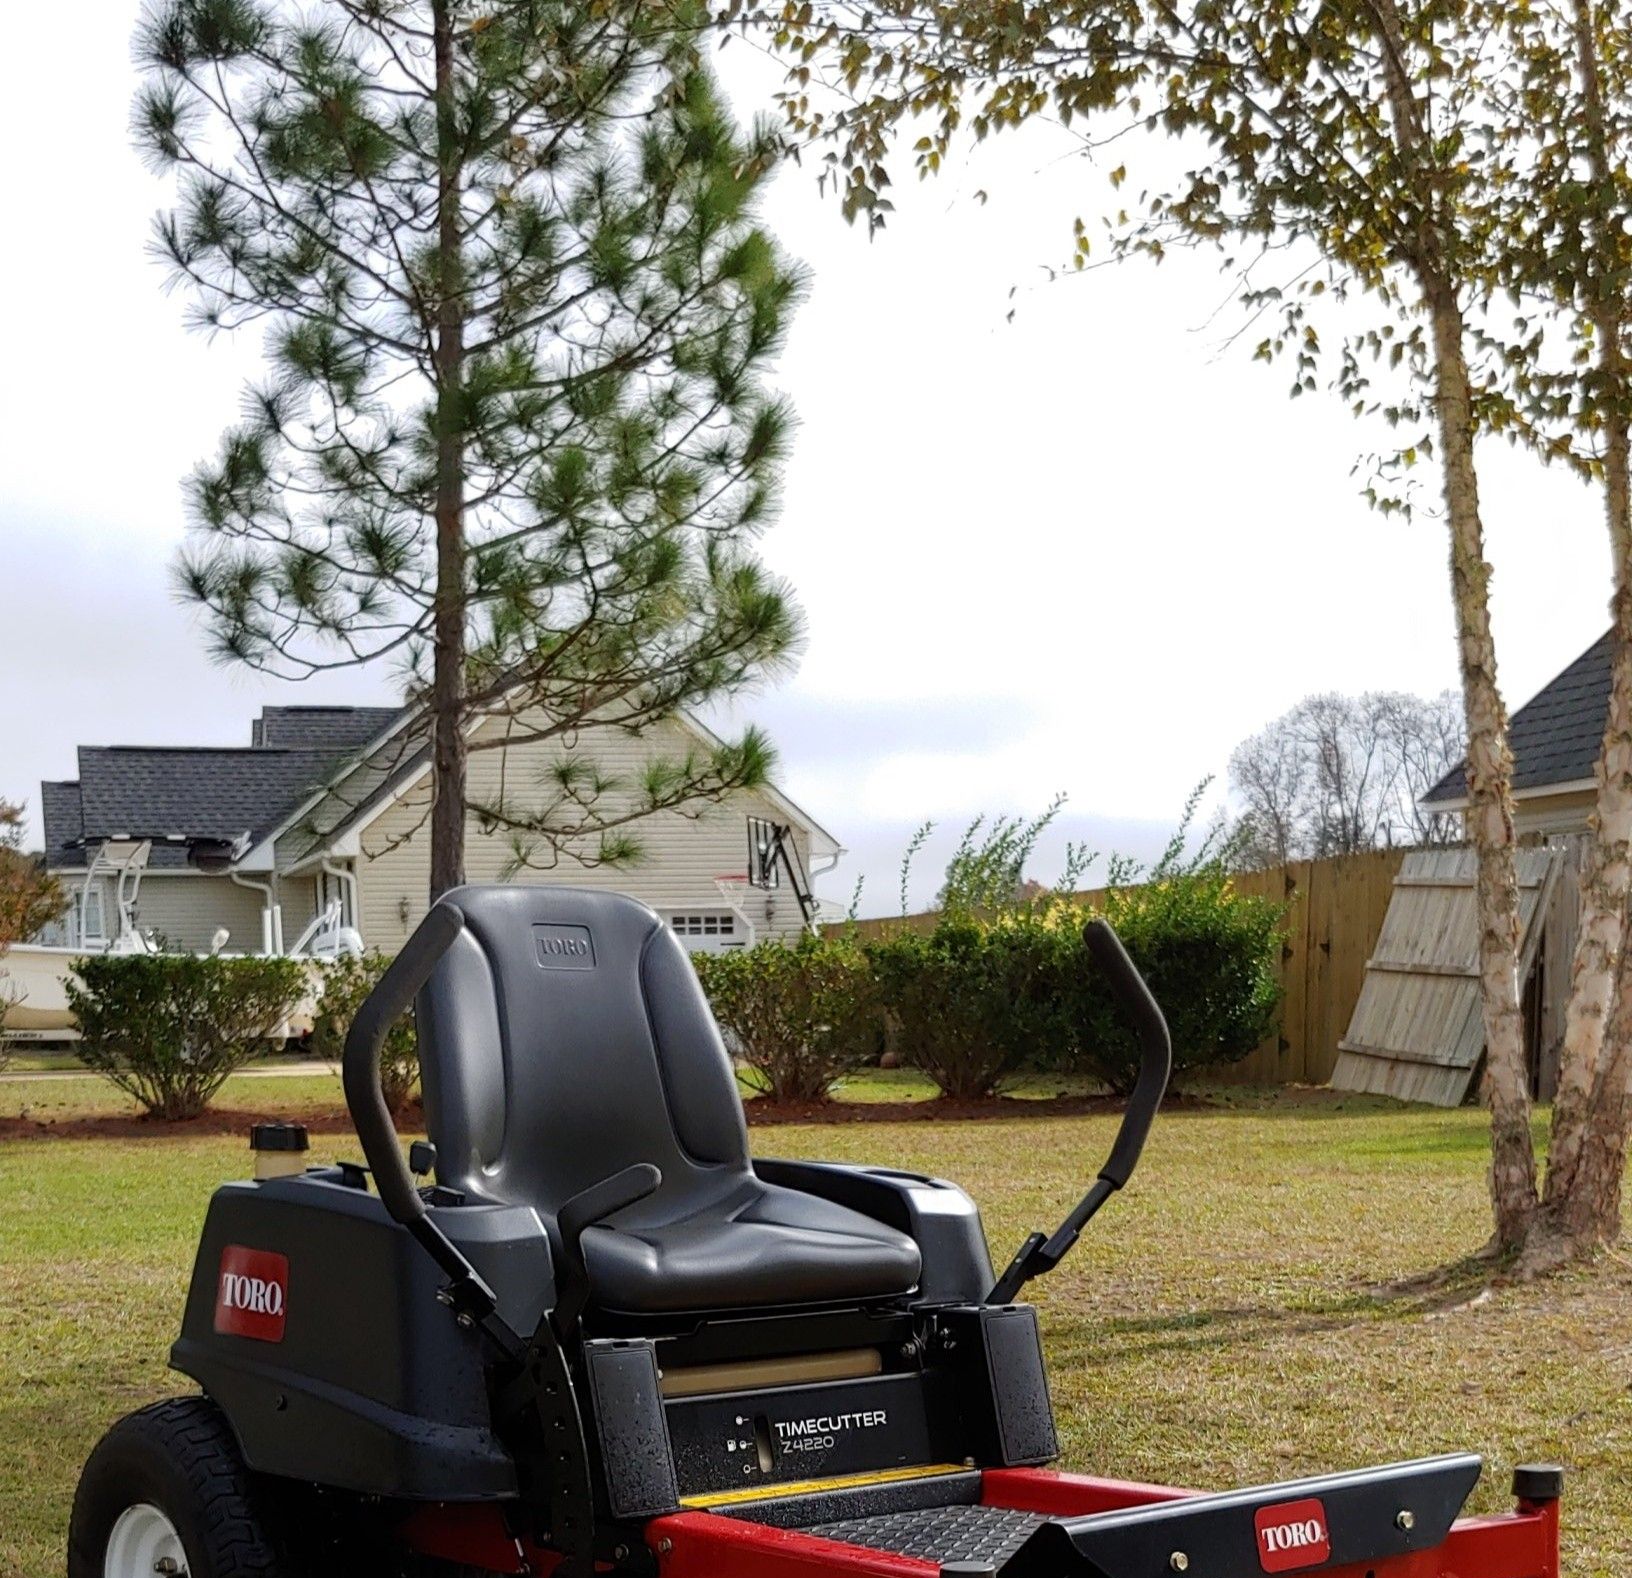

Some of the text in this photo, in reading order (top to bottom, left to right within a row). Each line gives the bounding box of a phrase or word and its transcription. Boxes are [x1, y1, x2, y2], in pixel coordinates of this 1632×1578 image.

[537, 938, 587, 955] TORO
[775, 1411, 887, 1437] TIMECUTTER
[781, 1436, 835, 1454] Z4220
